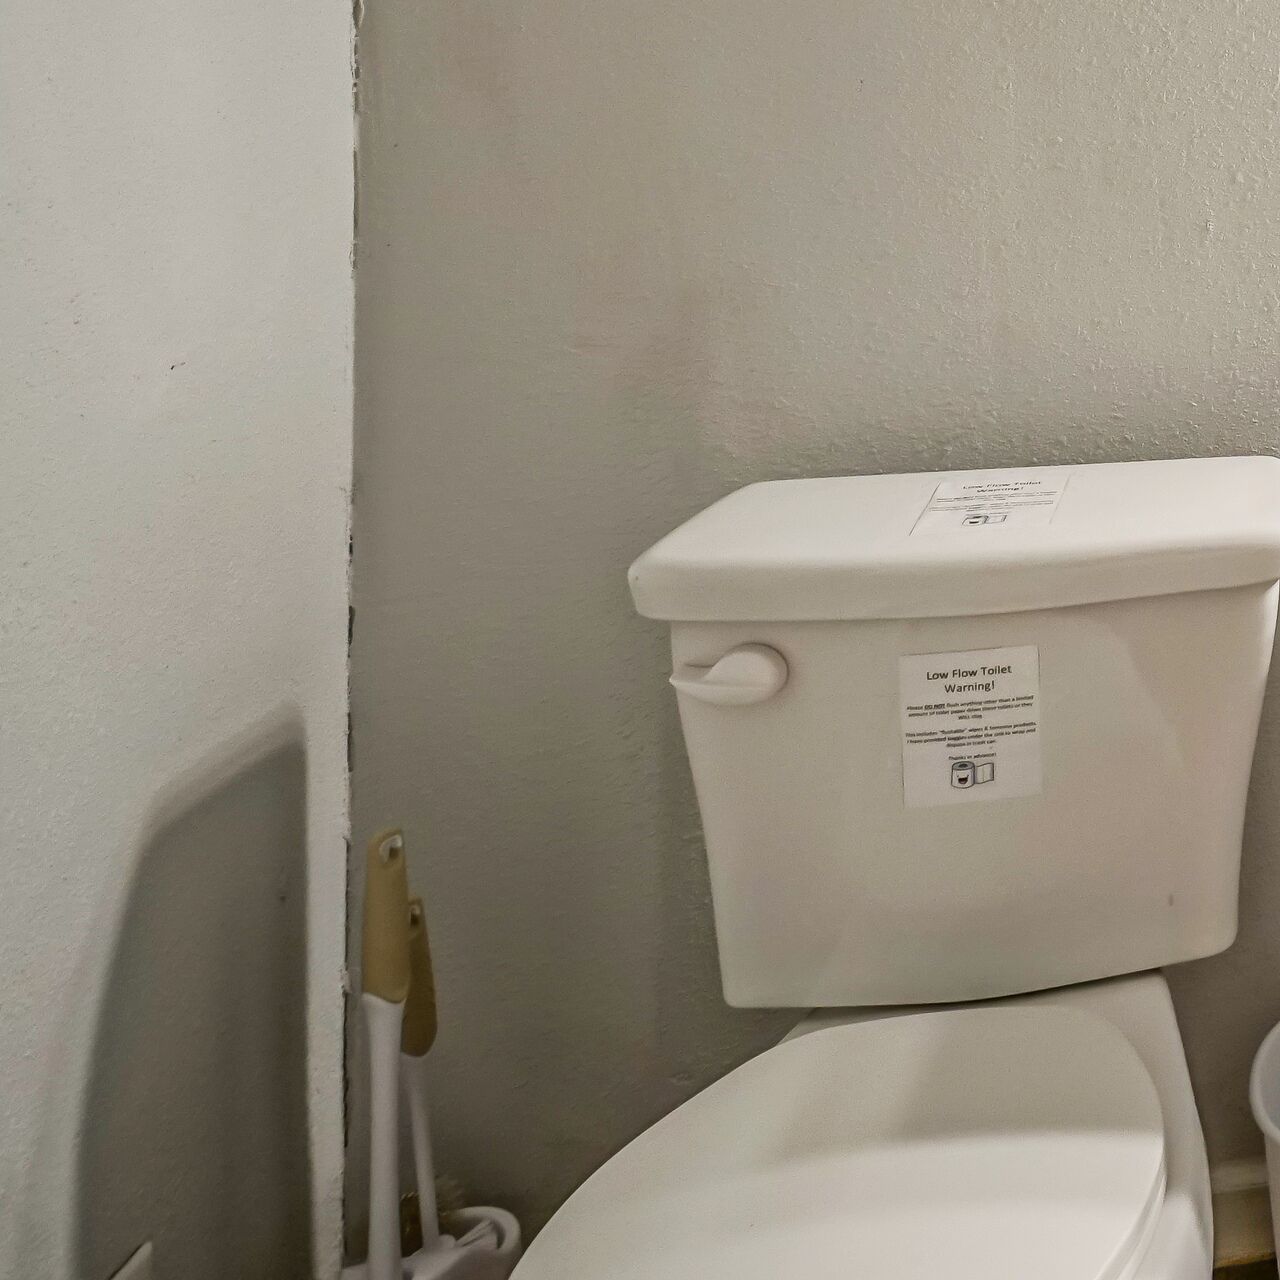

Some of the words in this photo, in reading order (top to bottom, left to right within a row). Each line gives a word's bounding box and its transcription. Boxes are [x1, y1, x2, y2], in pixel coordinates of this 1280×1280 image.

[926, 670, 949, 681] Low
[952, 668, 978, 679] Flow
[980, 665, 1012, 676] Toilet
[944, 680, 995, 694] Warning!
